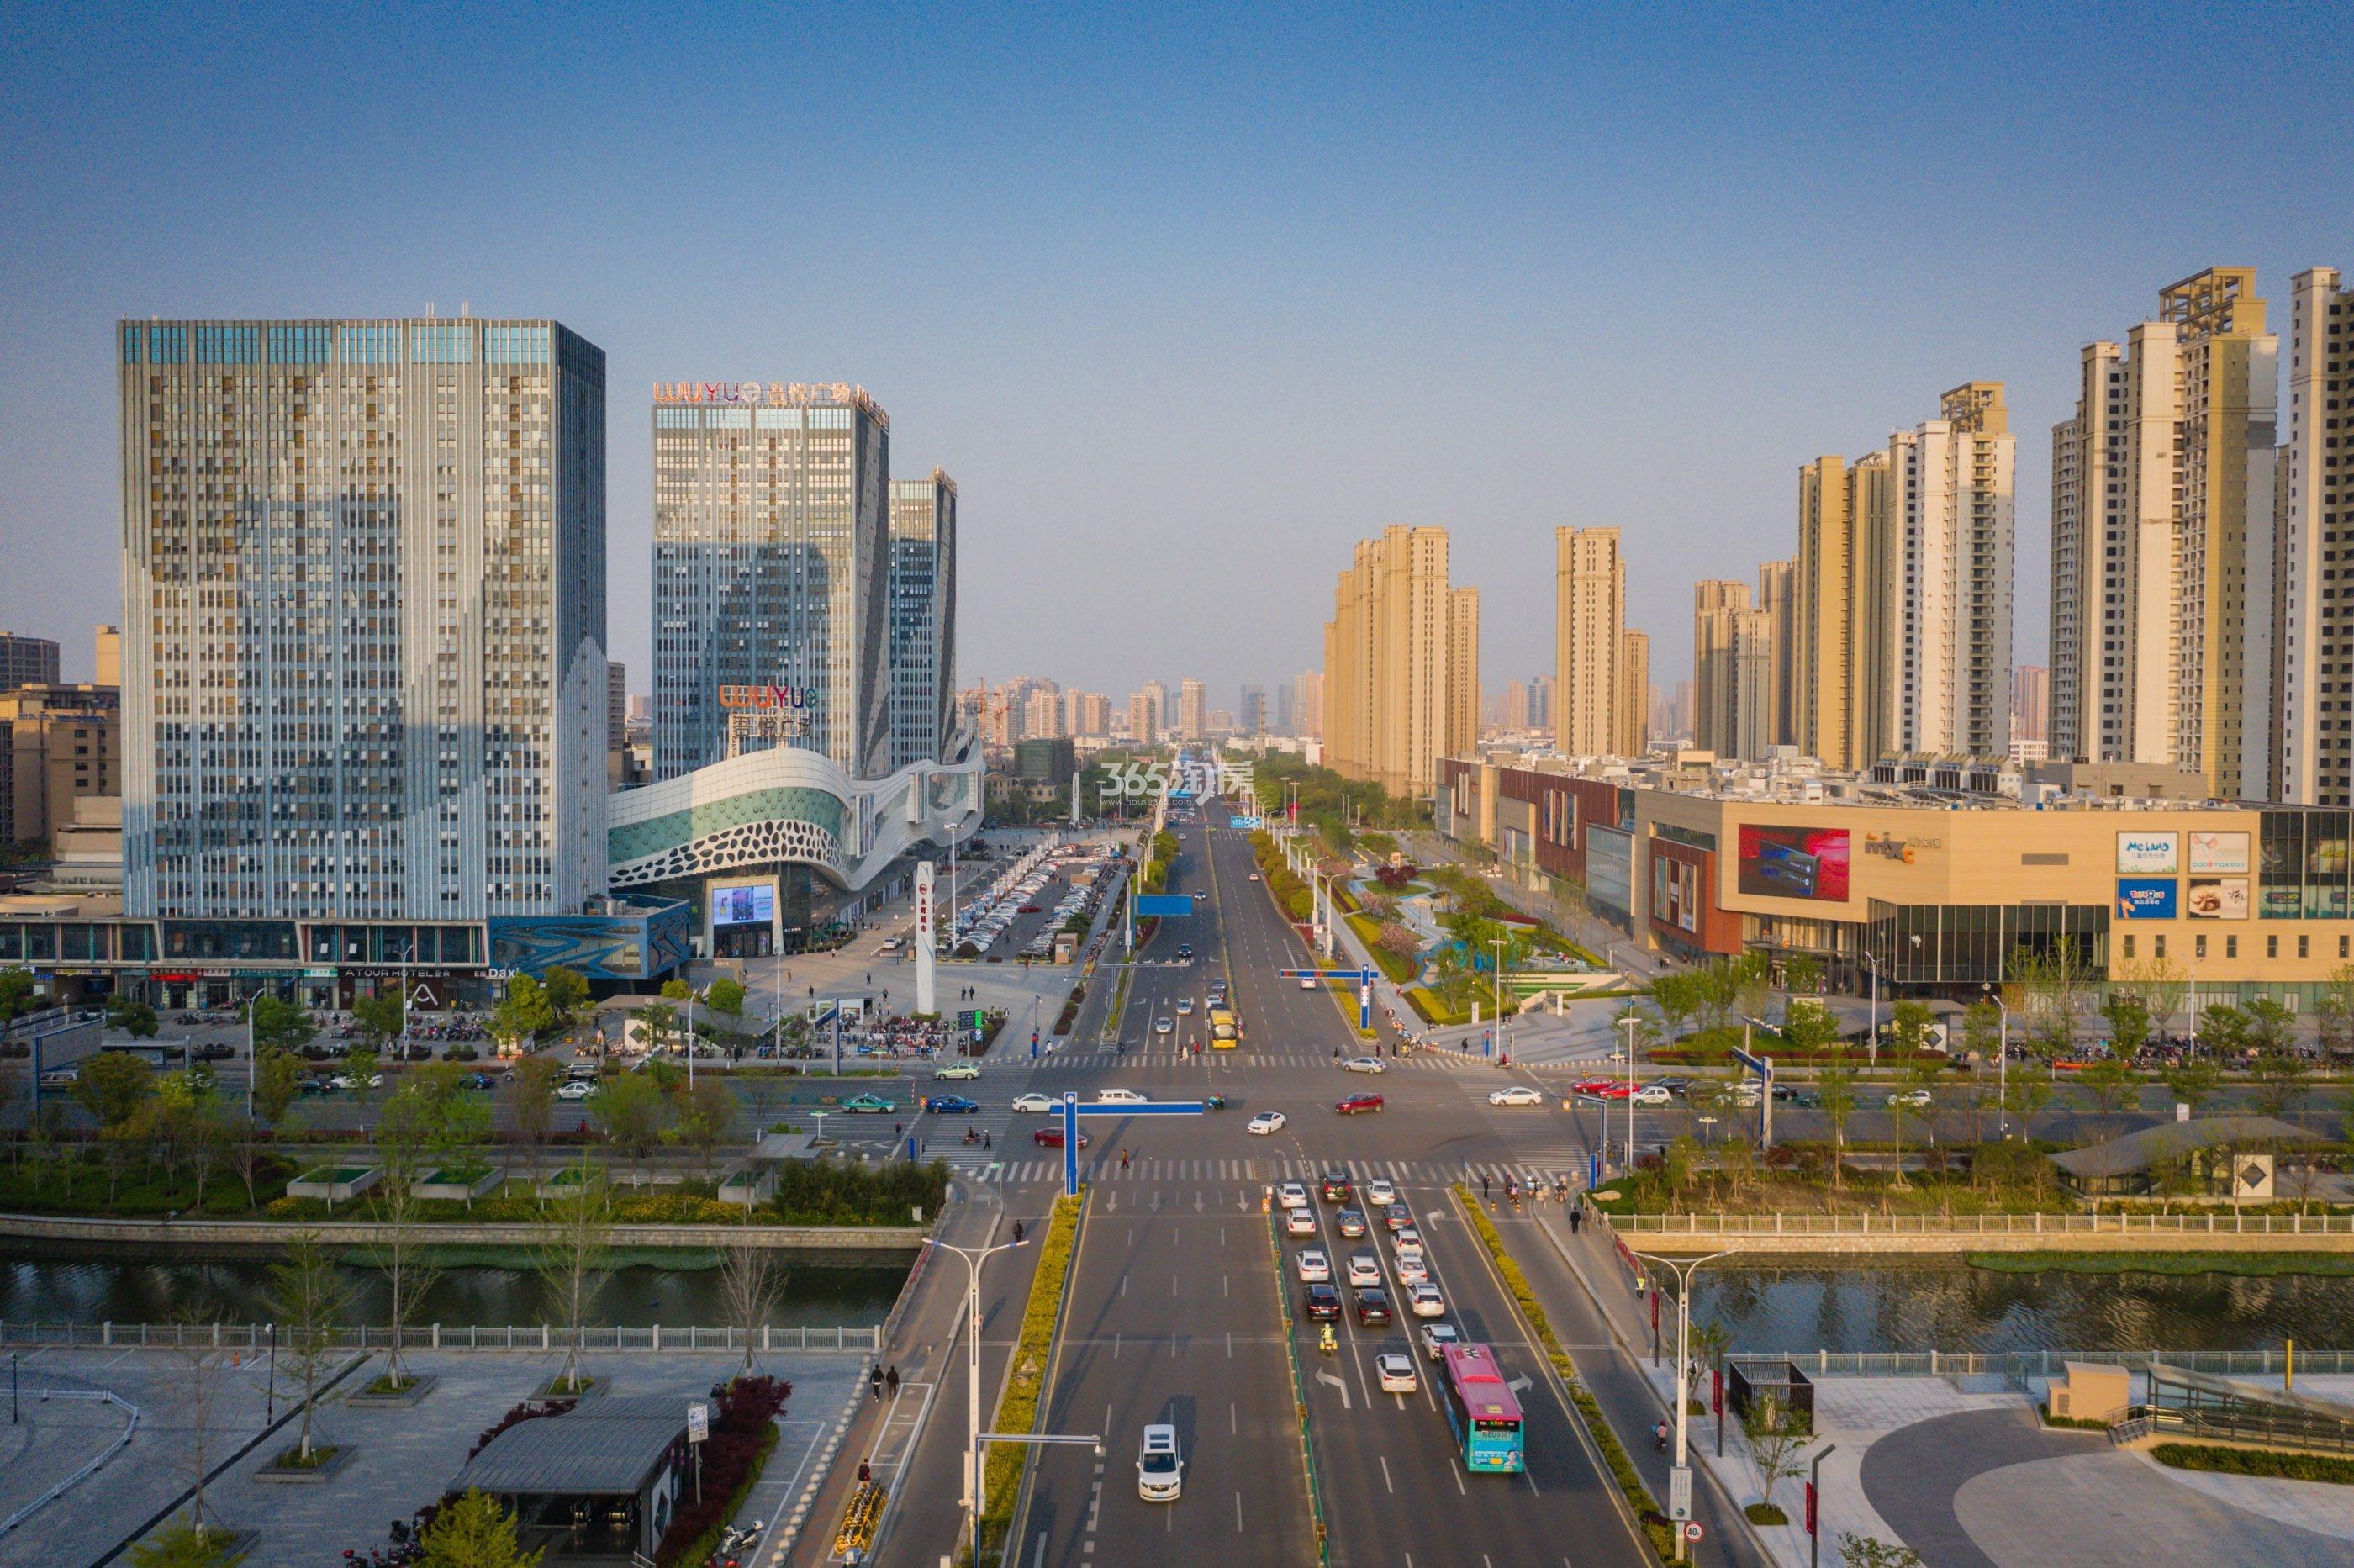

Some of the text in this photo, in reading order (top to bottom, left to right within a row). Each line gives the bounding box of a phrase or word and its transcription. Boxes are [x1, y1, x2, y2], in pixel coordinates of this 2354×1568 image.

[733, 715, 811, 737] 吾悦广场
[345, 969, 388, 977] ATOUR
